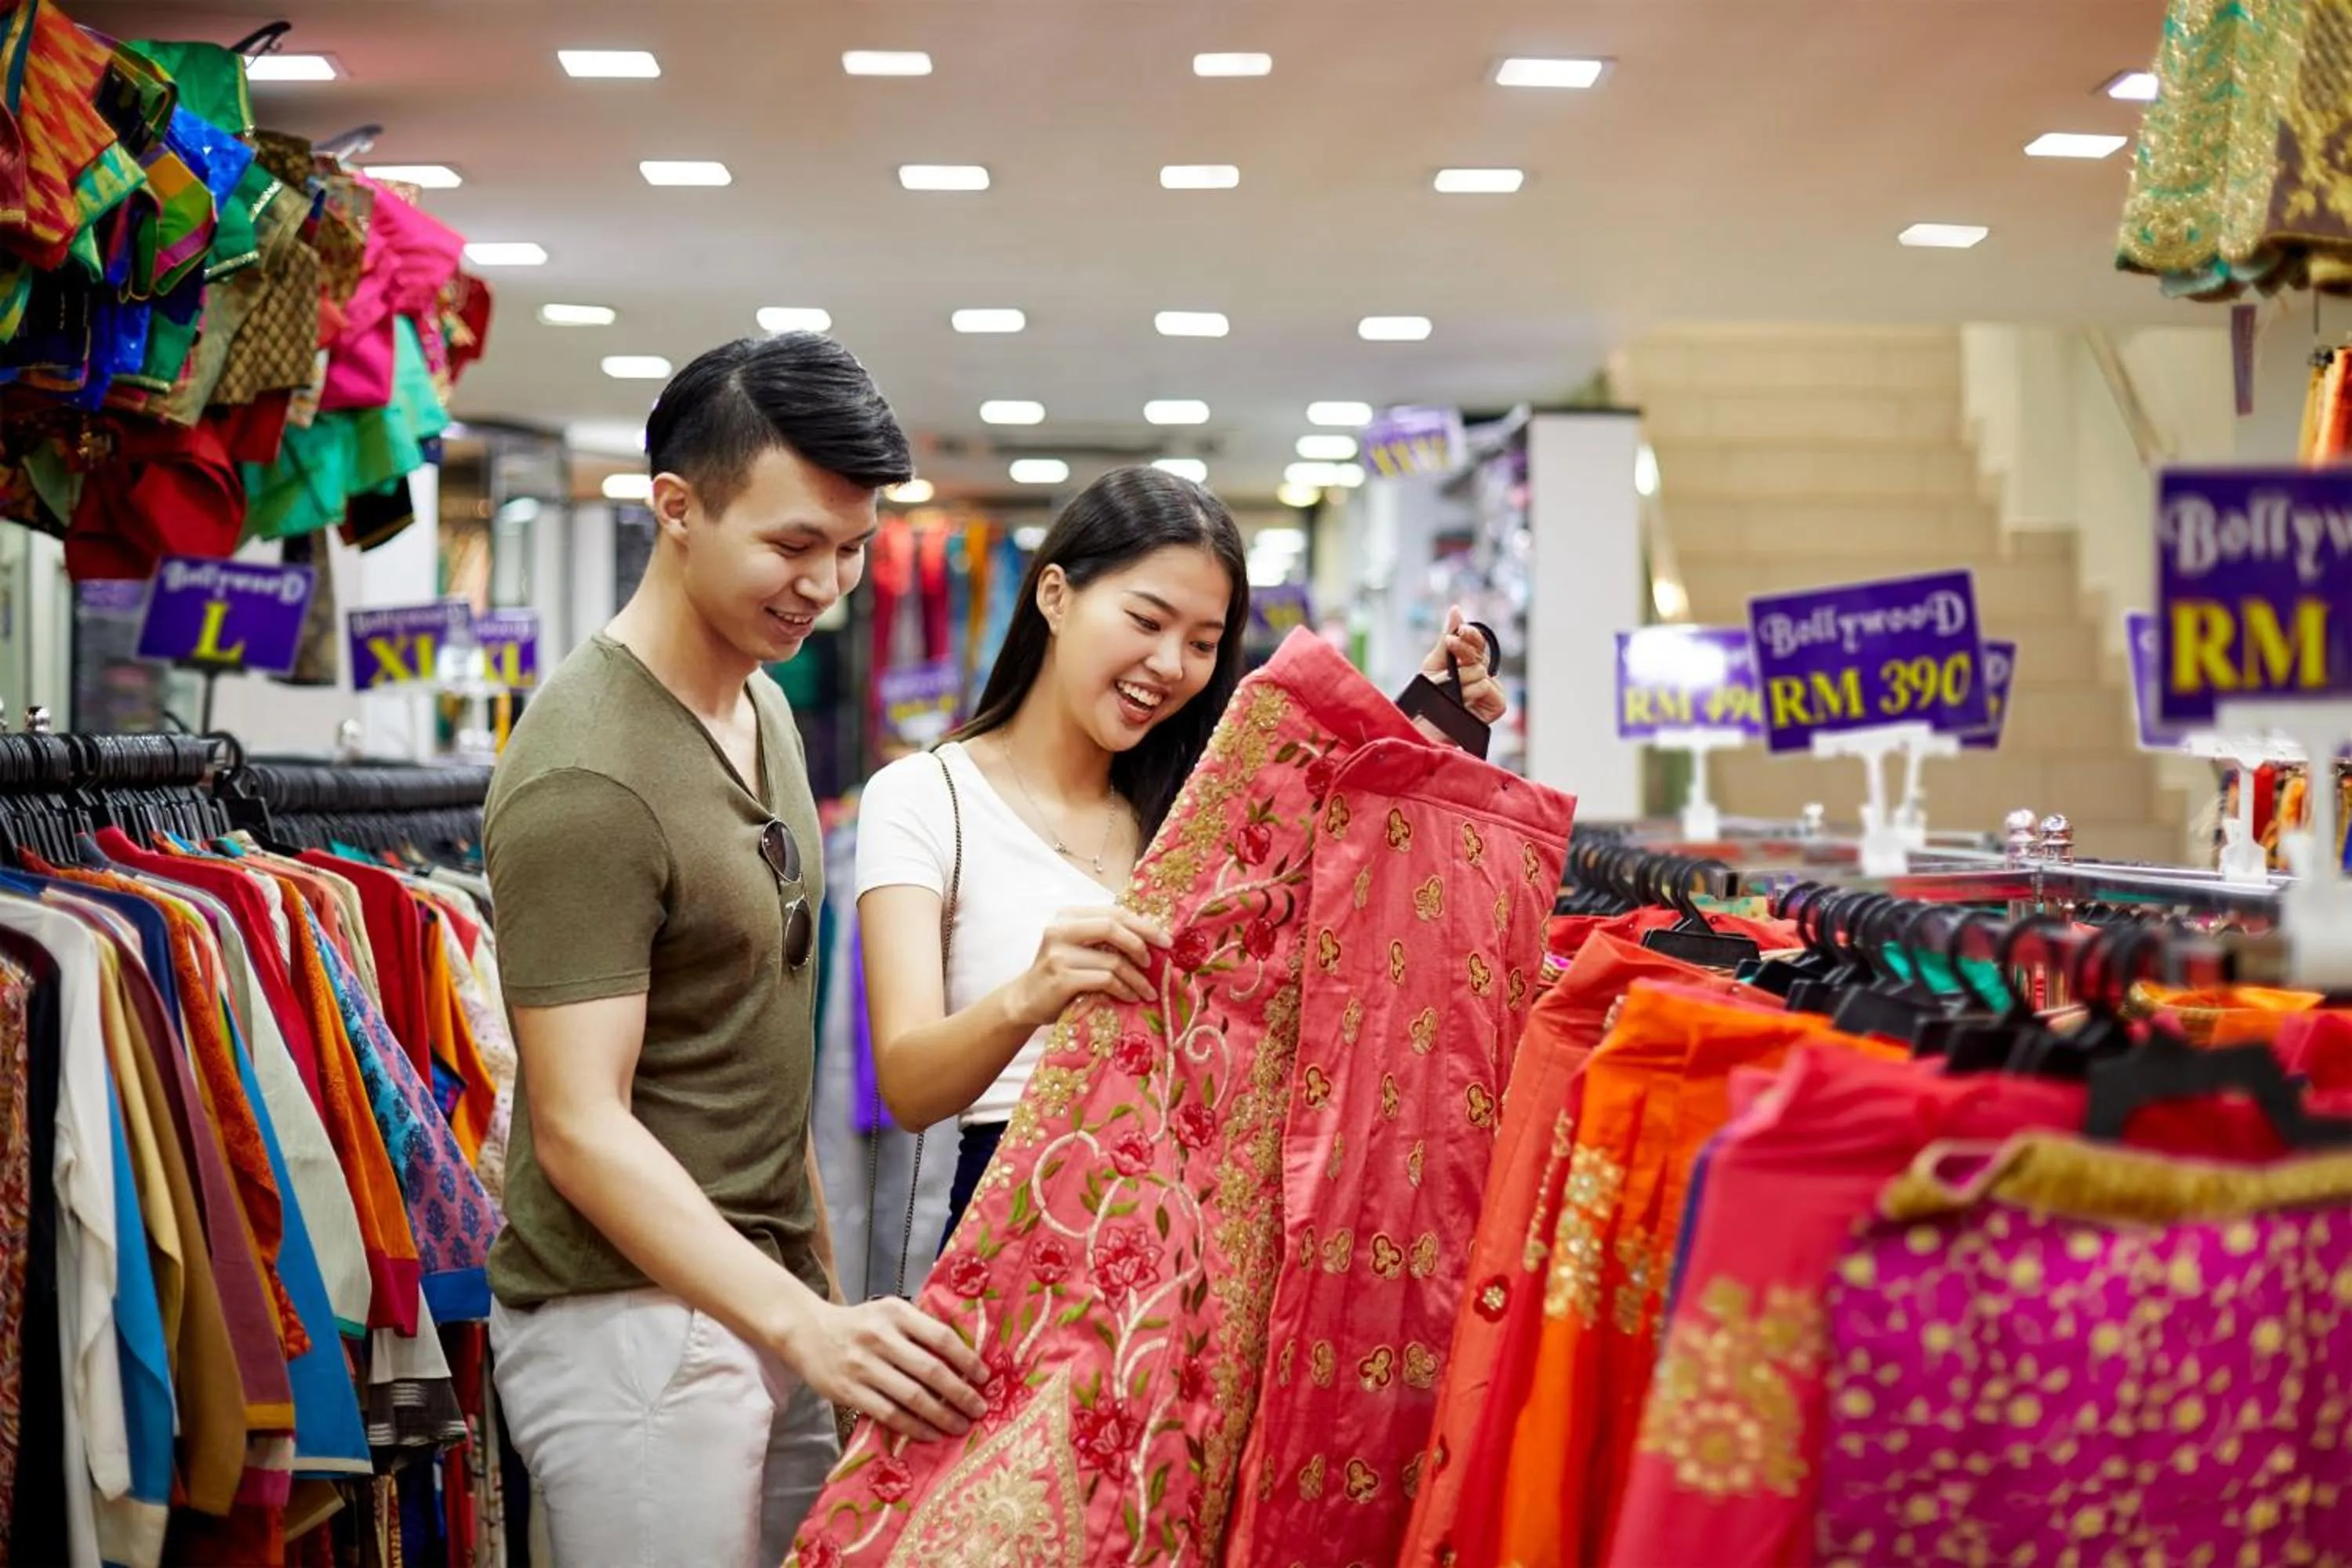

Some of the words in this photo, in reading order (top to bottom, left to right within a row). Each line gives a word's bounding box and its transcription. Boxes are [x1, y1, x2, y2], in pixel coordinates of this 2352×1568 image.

[193, 601, 247, 662] L
[2170, 597, 2328, 693] RM
[1625, 684, 1691, 726] RM
[1769, 667, 1864, 728] RM
[1878, 651, 1972, 715] 390
